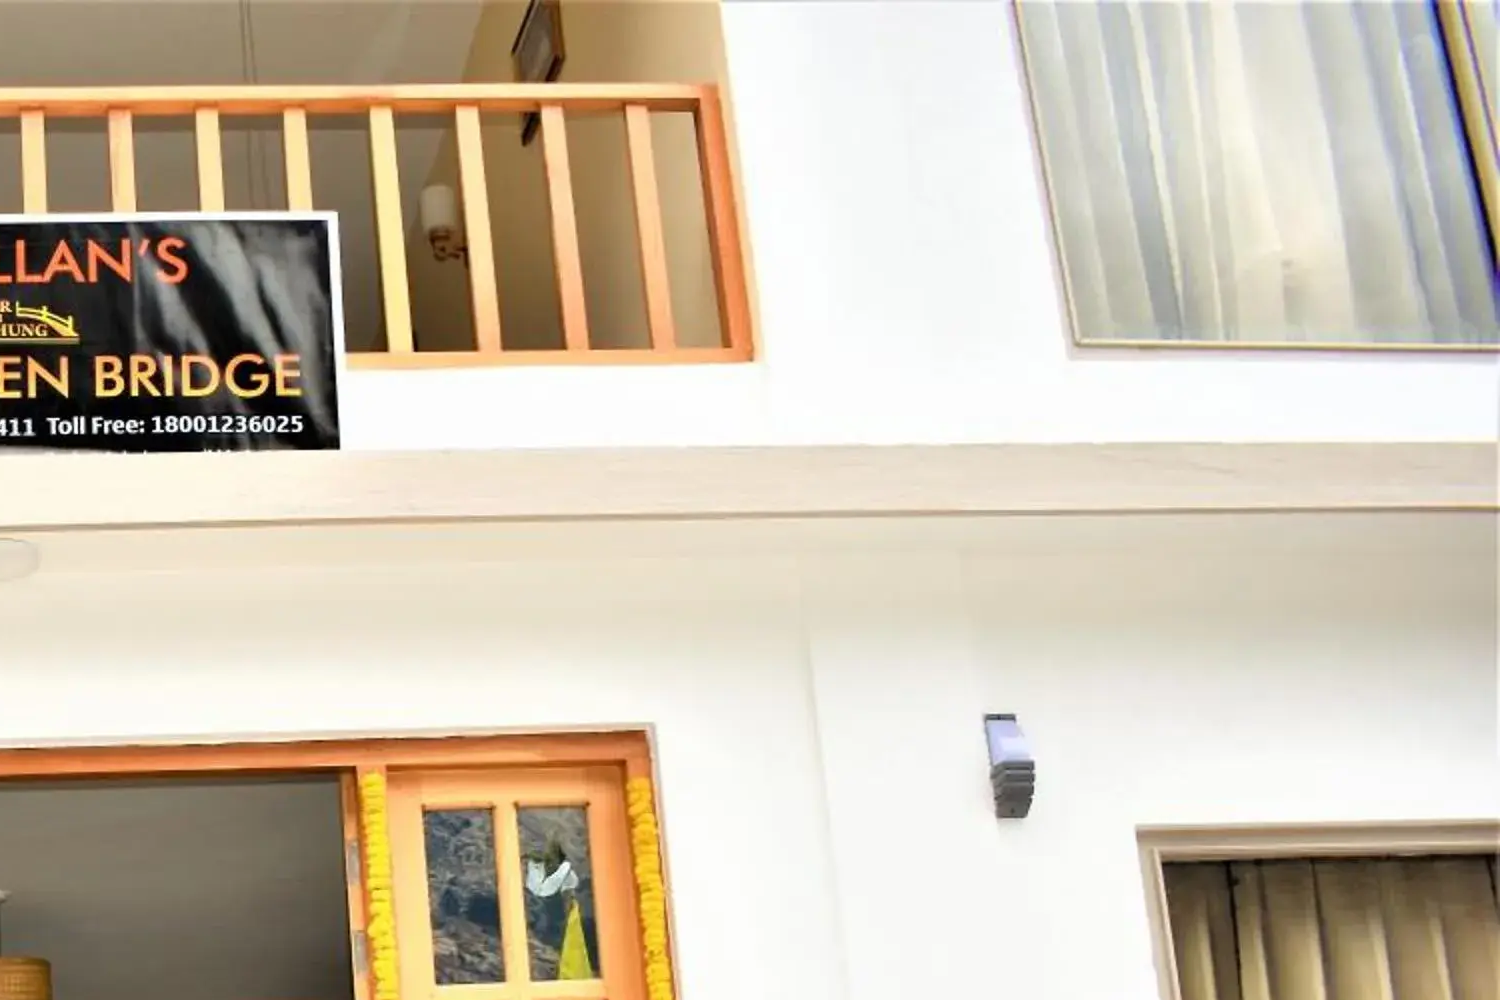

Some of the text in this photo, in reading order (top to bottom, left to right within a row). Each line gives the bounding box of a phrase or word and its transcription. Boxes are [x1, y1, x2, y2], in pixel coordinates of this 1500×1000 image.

[94, 352, 303, 399] BRIDGE
[46, 417, 86, 435] Toll
[91, 416, 146, 436] Free:
[151, 414, 305, 434] 18001236025
